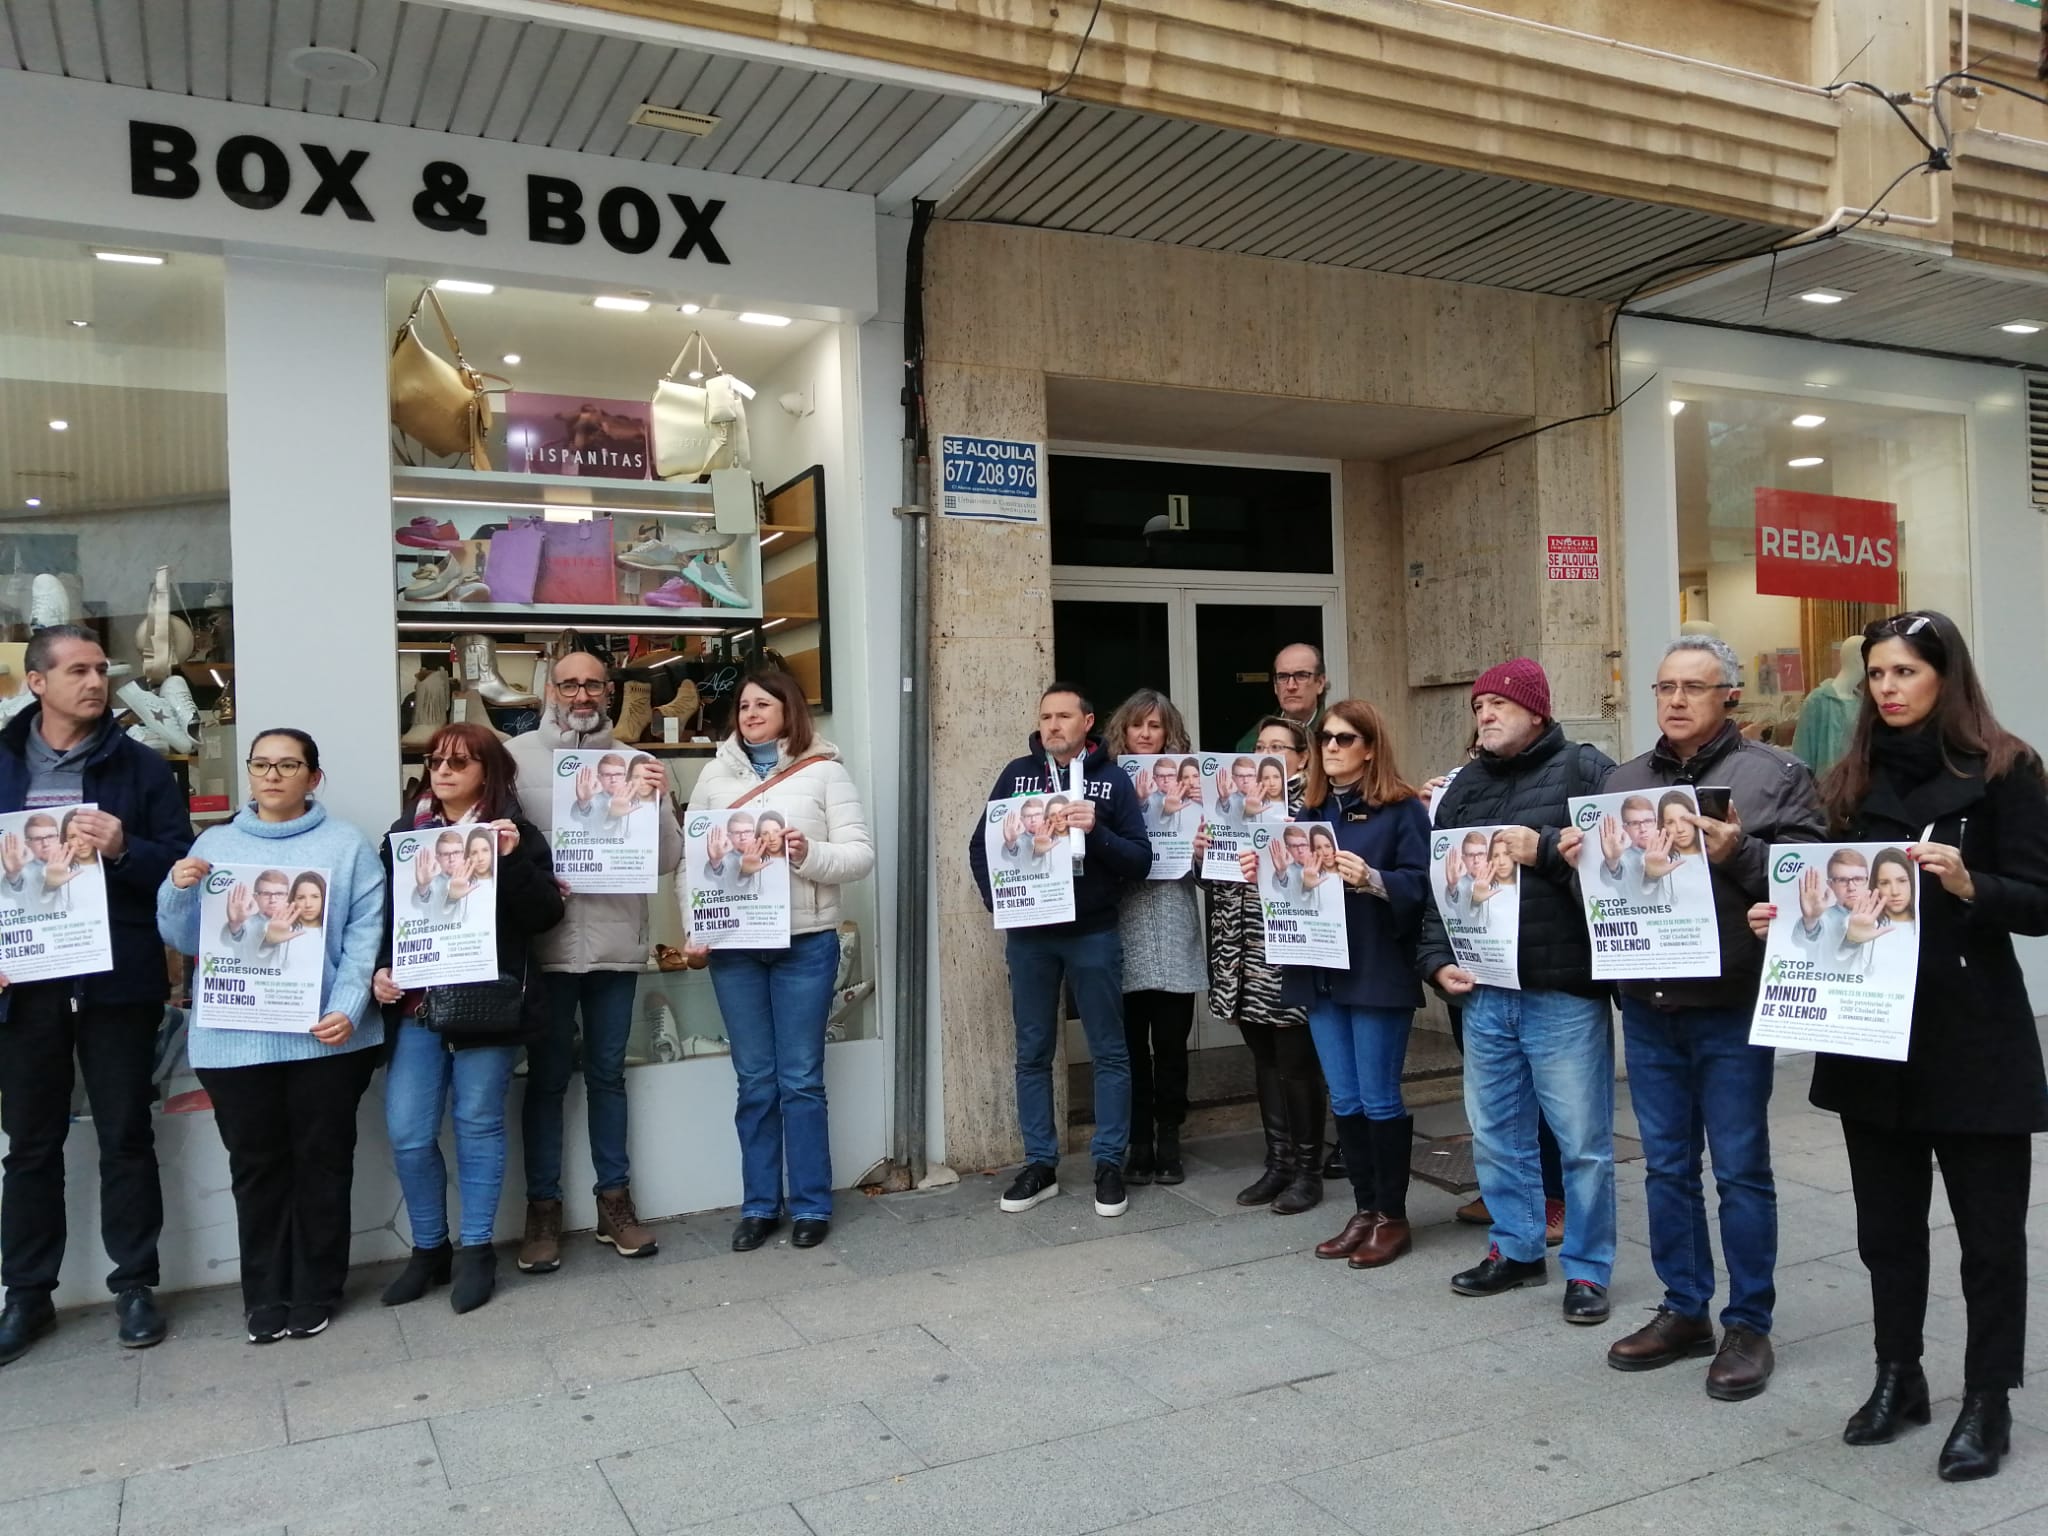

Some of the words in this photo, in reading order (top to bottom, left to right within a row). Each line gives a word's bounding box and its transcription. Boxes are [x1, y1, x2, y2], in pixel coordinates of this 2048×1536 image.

[129, 120, 375, 223] BOX
[412, 161, 487, 236] &
[528, 173, 731, 265] BOX
[944, 440, 963, 455] SE
[966, 442, 1034, 461] ALQUILA
[525, 448, 643, 468] HISPANITAS
[945, 459, 974, 482] 677
[977, 462, 1004, 485] 208
[1007, 464, 1035, 488] 976
[1173, 497, 1185, 527] 1
[1761, 526, 1892, 568] REBAJAS
[1549, 554, 1559, 566] SE
[1562, 554, 1598, 566] ALQUILA
[1550, 568, 1563, 579] 671
[1566, 568, 1580, 579] 657
[1582, 568, 1597, 579] 652
[556, 849, 593, 861] MINUTO
[1207, 852, 1215, 860] DE
[555, 863, 566, 873] DE
[568, 862, 603, 873] SILENCIO
[999, 869, 1020, 877] STOP
[1000, 873, 1050, 883] AGRESIONES
[699, 889, 724, 897] STOP
[996, 886, 1026, 898] MINUTO
[701, 894, 758, 904] AGRESIONES
[997, 901, 1005, 909] DE
[1006, 898, 1035, 908] SILENCIO
[1599, 898, 1627, 908] STOP
[694, 907, 730, 920] MINUTO
[1272, 908, 1319, 917] AGRESIONES
[1601, 904, 1672, 916] AGRESIONES
[405, 919, 429, 927] STOP
[406, 922, 462, 935] AGRESIONES
[694, 922, 705, 931] DE
[706, 919, 740, 931] SILENCIO
[1268, 920, 1298, 932] MINUTO
[1594, 921, 1638, 938] MINUTO
[0, 929, 33, 947] INUTO
[1268, 933, 1277, 943] DE
[1278, 933, 1306, 944] SILENCIO
[5, 943, 45, 959] SILENCIO
[398, 938, 432, 954] MINUTO
[1597, 940, 1608, 952] DE
[1611, 938, 1651, 951] SILENCIO
[213, 957, 241, 965] STOP
[397, 955, 407, 966] DE
[408, 952, 440, 965] SILENCIO
[1780, 960, 1815, 970] STOP
[214, 966, 282, 976] AGRESIONES
[1779, 970, 1864, 984] AGRESIONES
[205, 977, 245, 992] MINUTO
[203, 993, 214, 1004] DE
[217, 994, 256, 1006] SILENCIO
[1765, 985, 1817, 1003] MINUTO
[1761, 1004, 1776, 1016] DE
[1778, 1005, 1827, 1021] SILENCIO
